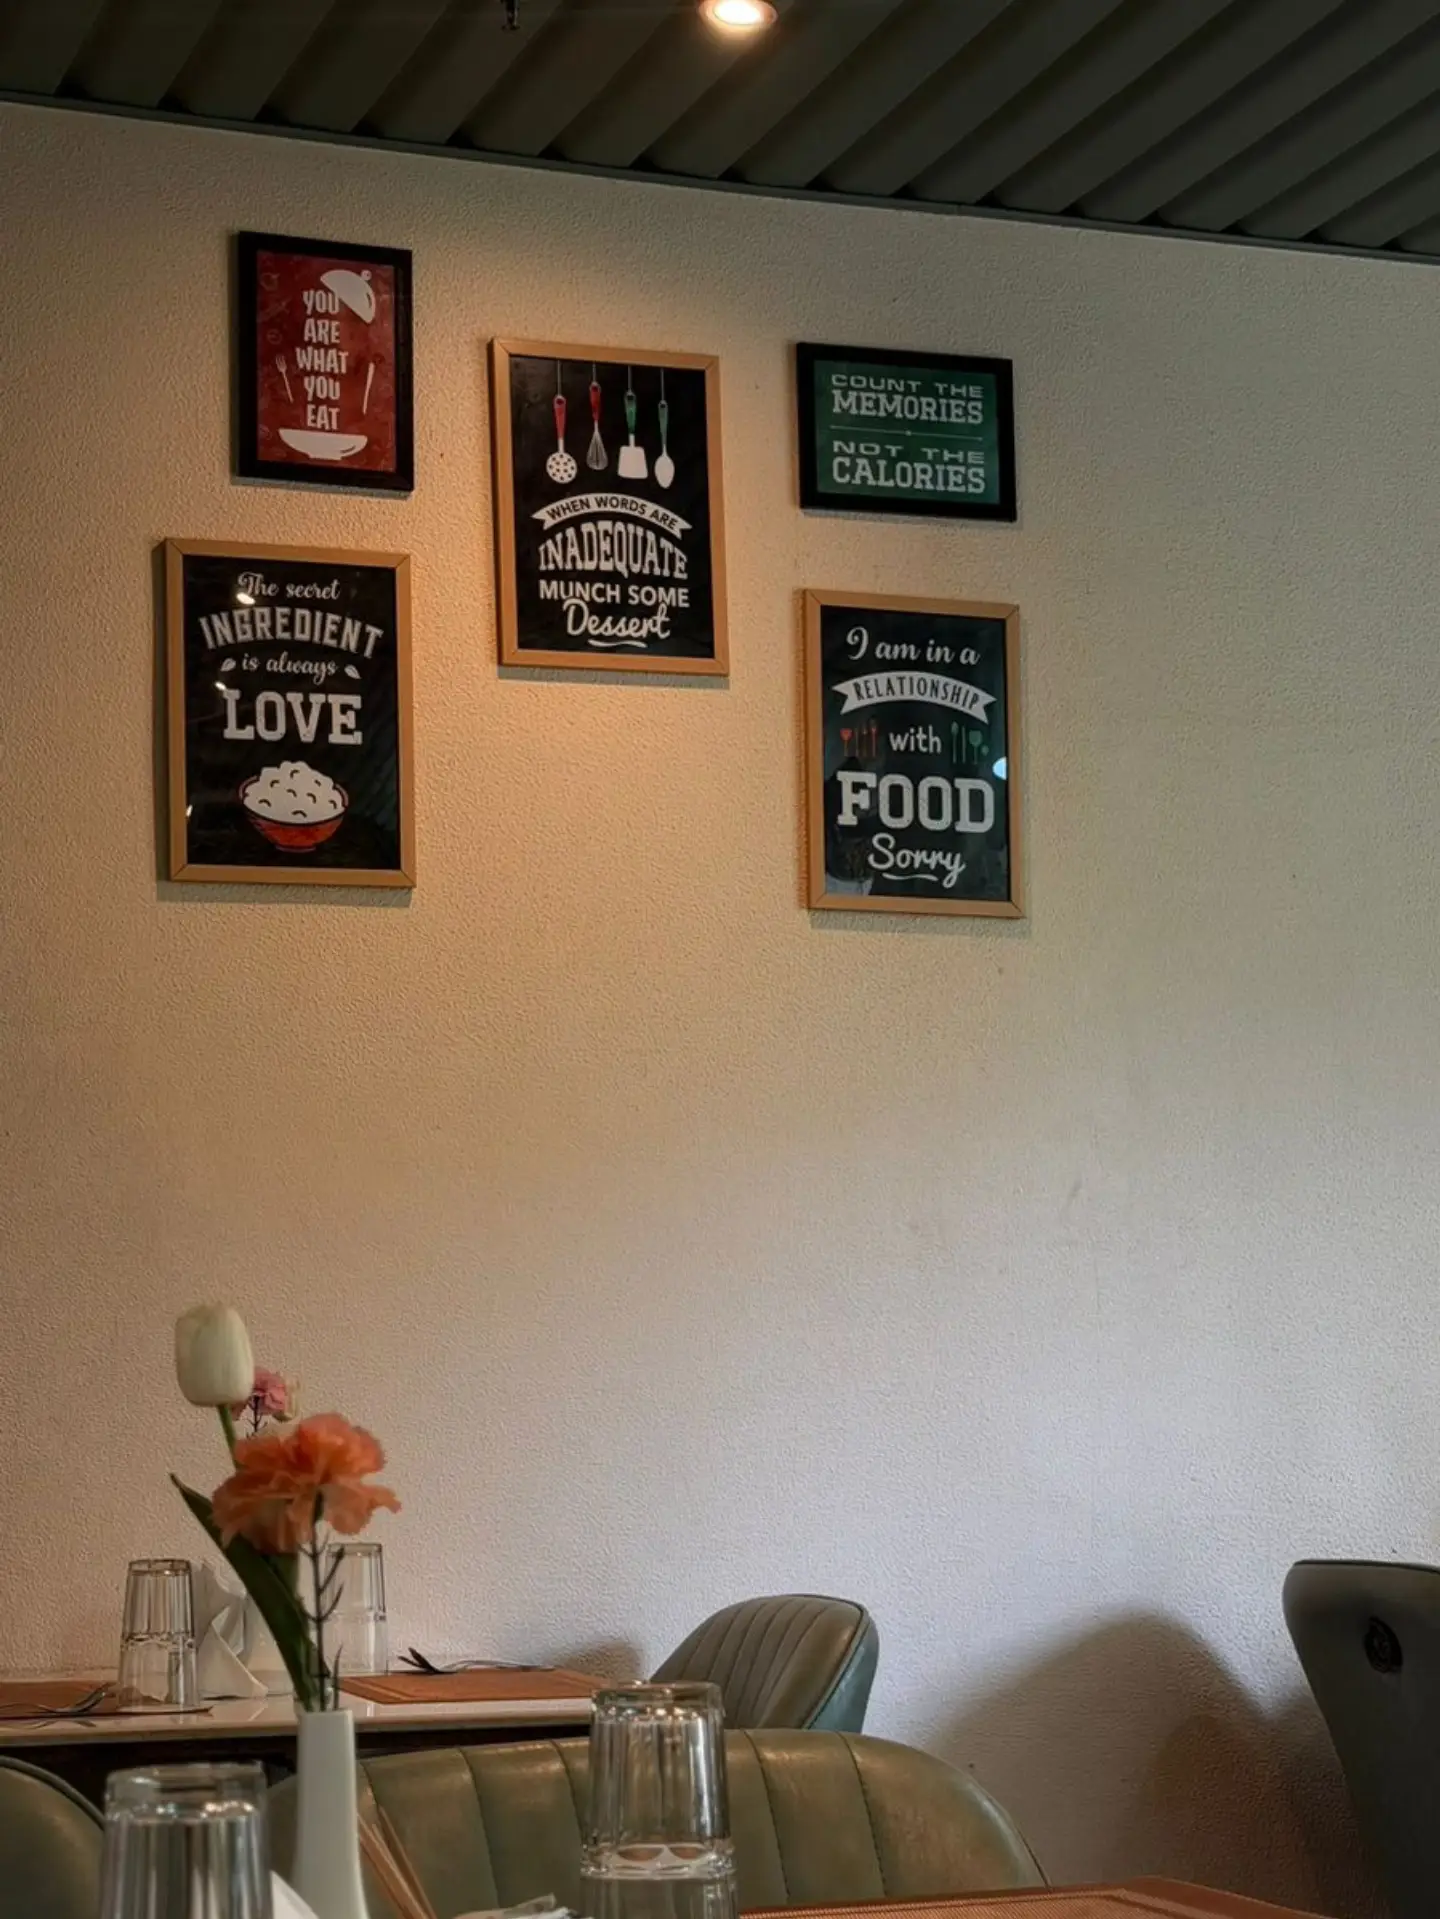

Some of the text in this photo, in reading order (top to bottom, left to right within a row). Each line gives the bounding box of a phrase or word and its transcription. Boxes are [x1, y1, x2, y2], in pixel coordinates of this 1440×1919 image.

[303, 290, 340, 315] YOU
[304, 319, 340, 345] ARE
[296, 347, 349, 373] WHAT
[304, 376, 340, 401] YOU
[831, 374, 984, 398] COUNT THE
[307, 404, 340, 430] EAT
[832, 389, 983, 424] MEMORIES
[833, 440, 984, 464] NOT THE
[832, 456, 986, 494] CALORIES
[547, 496, 678, 529] WHEN WORDS ARE
[538, 520, 688, 580] INADEQUATE
[238, 571, 341, 600] The secret
[539, 579, 690, 608] MUNCH SOME
[199, 606, 384, 659] INGREDIENT
[562, 598, 671, 639] Dessert
[846, 626, 981, 666] I am in a
[242, 651, 338, 685] is always
[853, 676, 979, 710] RELATIONSHIP
[223, 689, 362, 745] LOVE
[889, 725, 941, 754] with
[836, 770, 995, 833] FOOD
[868, 832, 965, 888] Sorry
